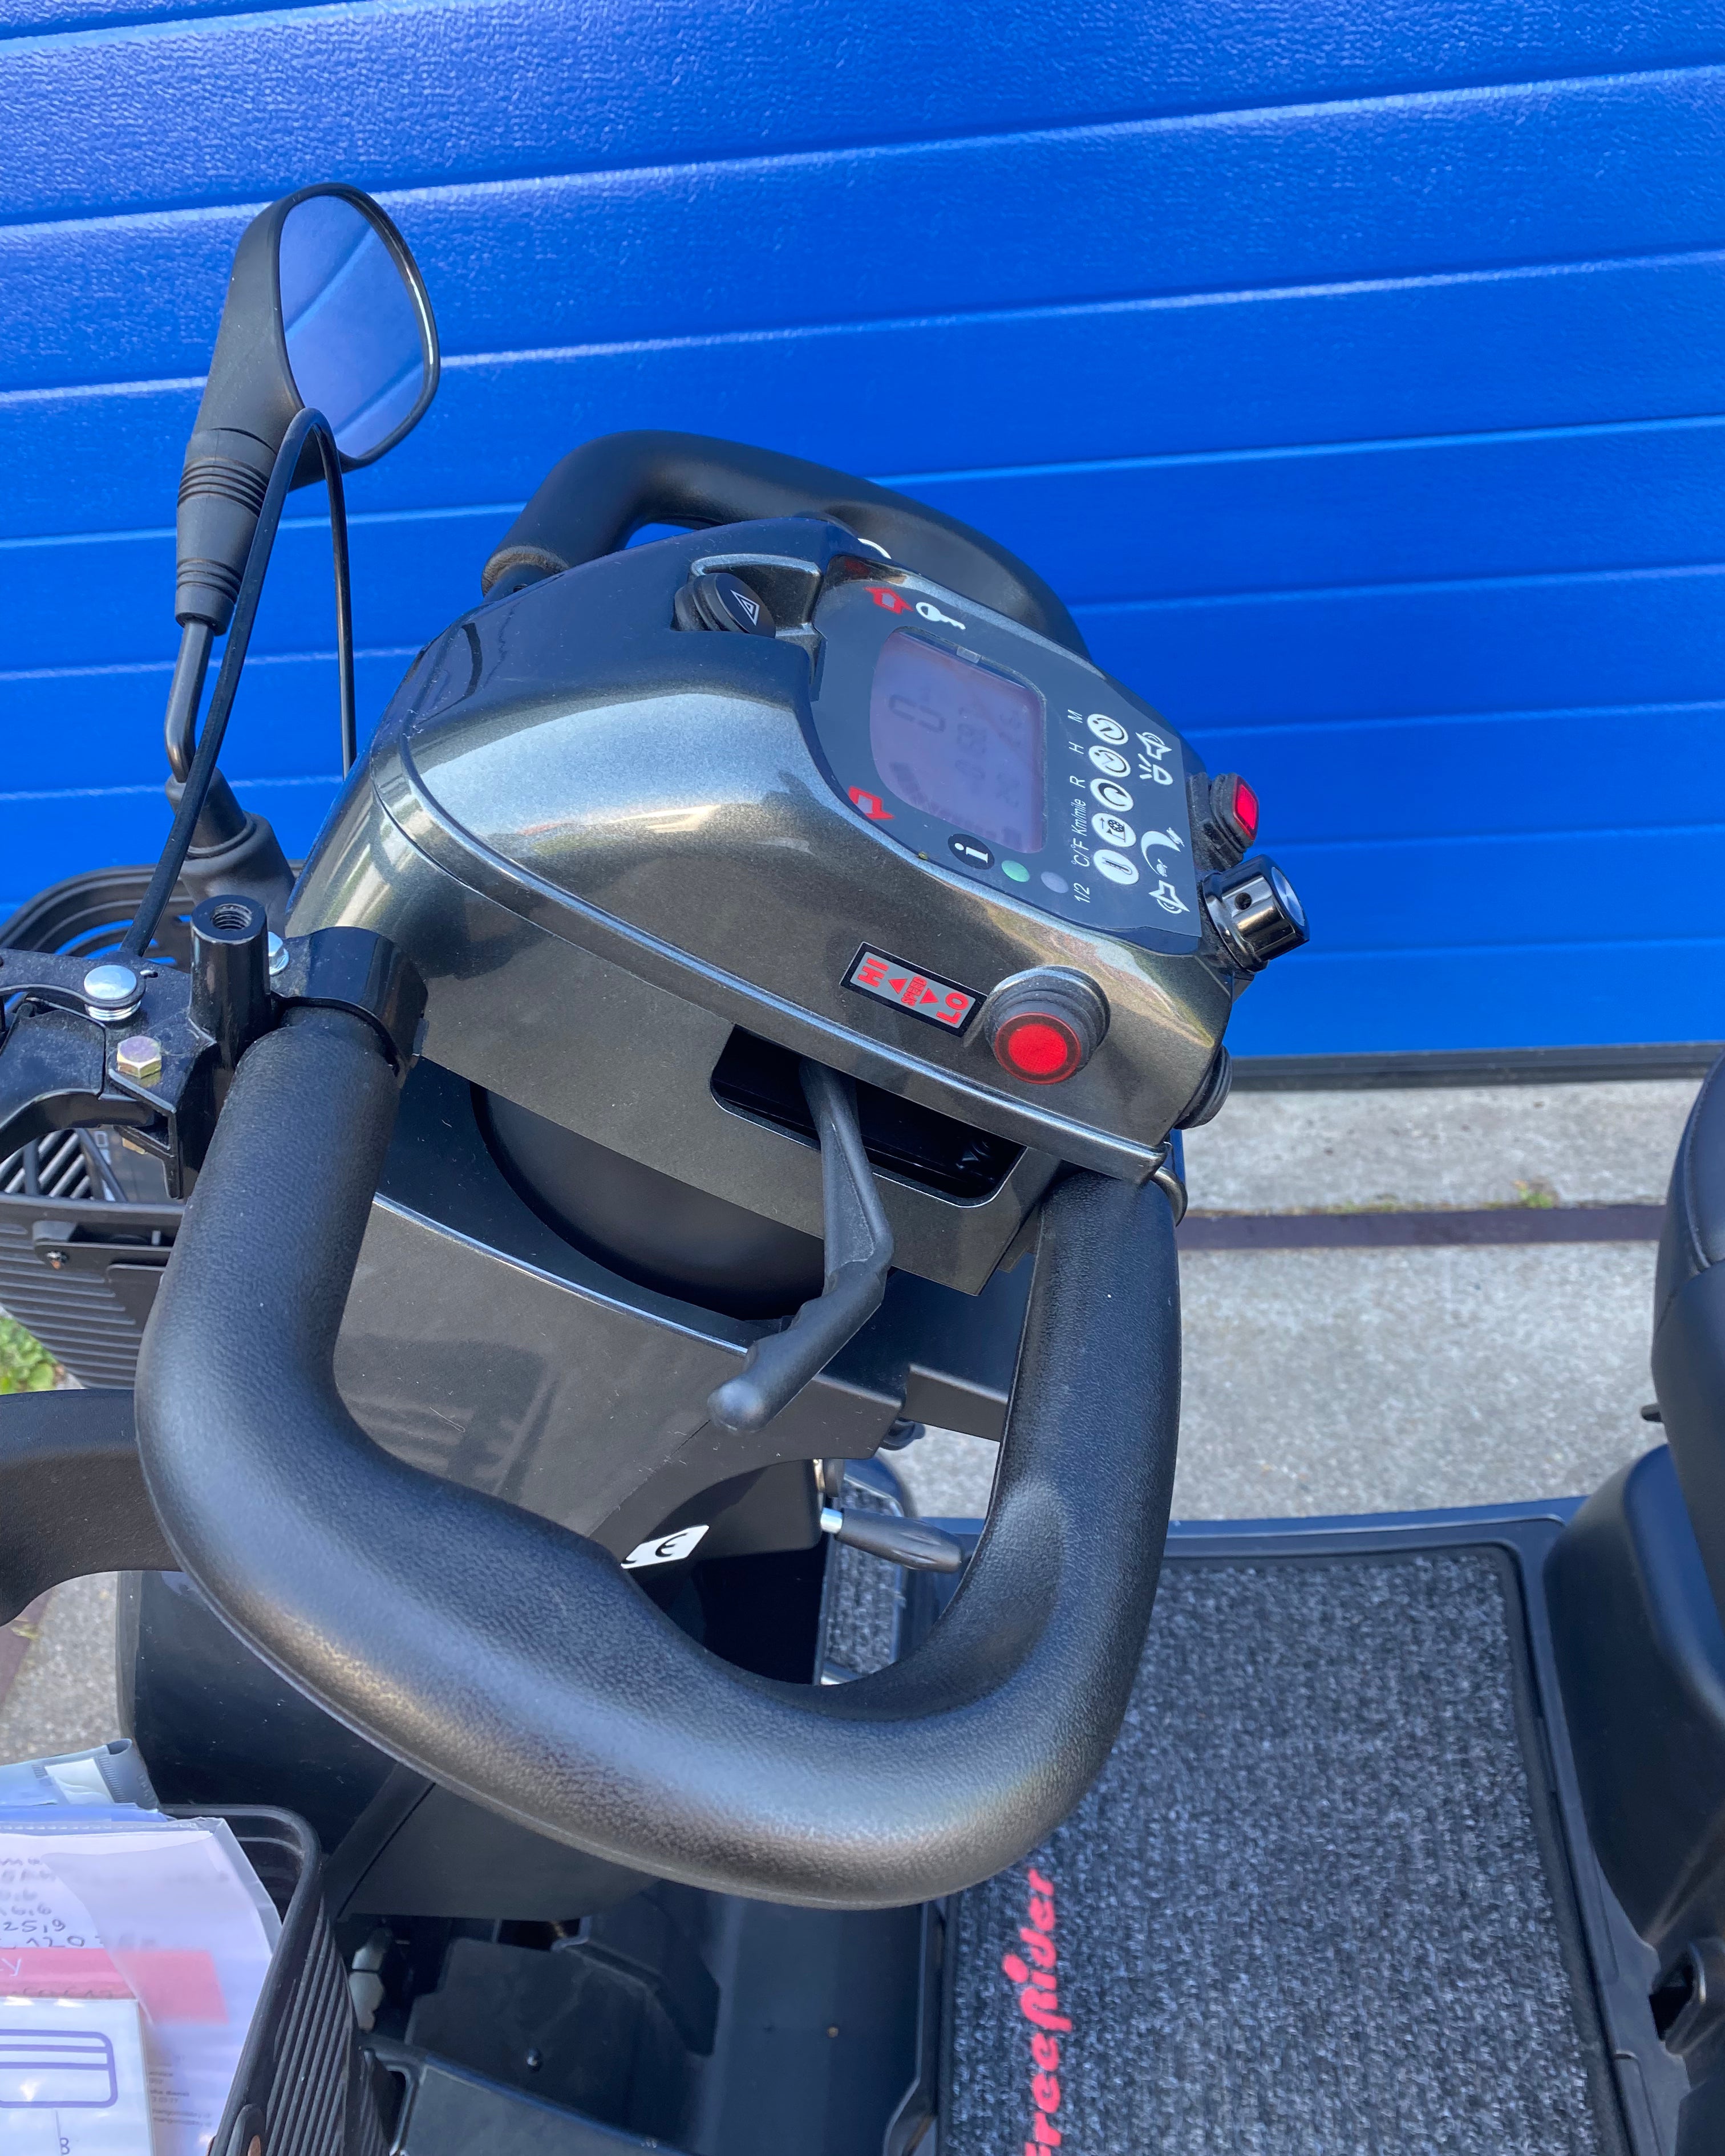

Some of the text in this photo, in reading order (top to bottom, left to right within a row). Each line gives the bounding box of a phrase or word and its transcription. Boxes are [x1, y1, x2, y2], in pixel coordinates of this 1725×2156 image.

[1067, 710, 1083, 723] M
[1068, 741, 1084, 755] H
[1070, 775, 1086, 788] R
[1070, 798, 1088, 837] Km/mile
[1073, 882, 1091, 903] 1/2
[857, 958, 889, 987] HI
[901, 976, 927, 1007] SPEED
[936, 992, 969, 1024] LO
[59, 2137, 71, 2155] B
